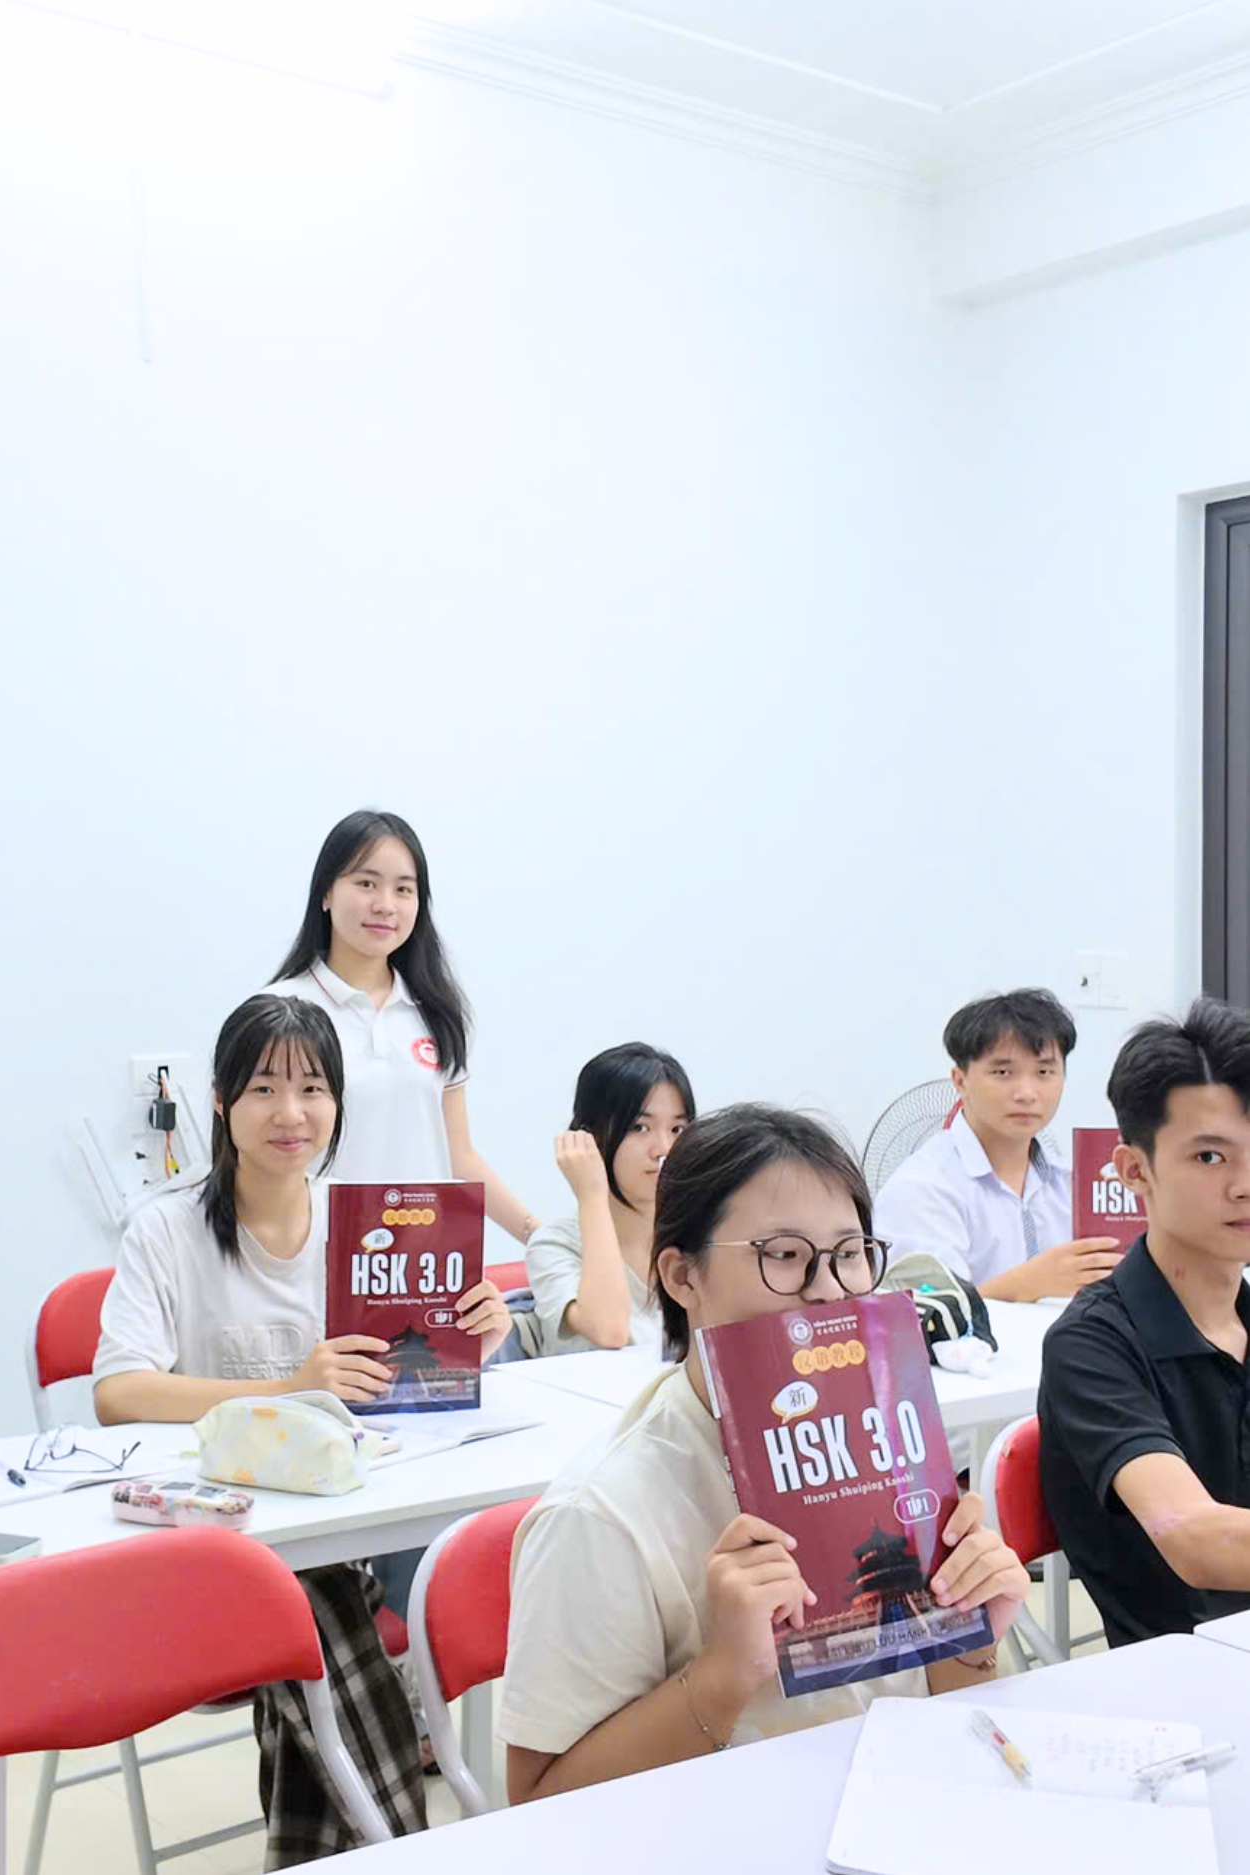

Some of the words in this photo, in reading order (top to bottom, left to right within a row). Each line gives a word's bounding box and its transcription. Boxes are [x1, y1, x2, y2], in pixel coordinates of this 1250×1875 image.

[1092, 1181, 1138, 1214] HSK
[351, 1253, 408, 1295] HSK
[419, 1251, 463, 1294] 3.0
[789, 1387, 807, 1407] 新
[763, 1414, 859, 1494] HSK
[862, 1400, 926, 1472] 3.0
[803, 1491, 838, 1506] Hanyu
[839, 1481, 884, 1497] Shuiping
